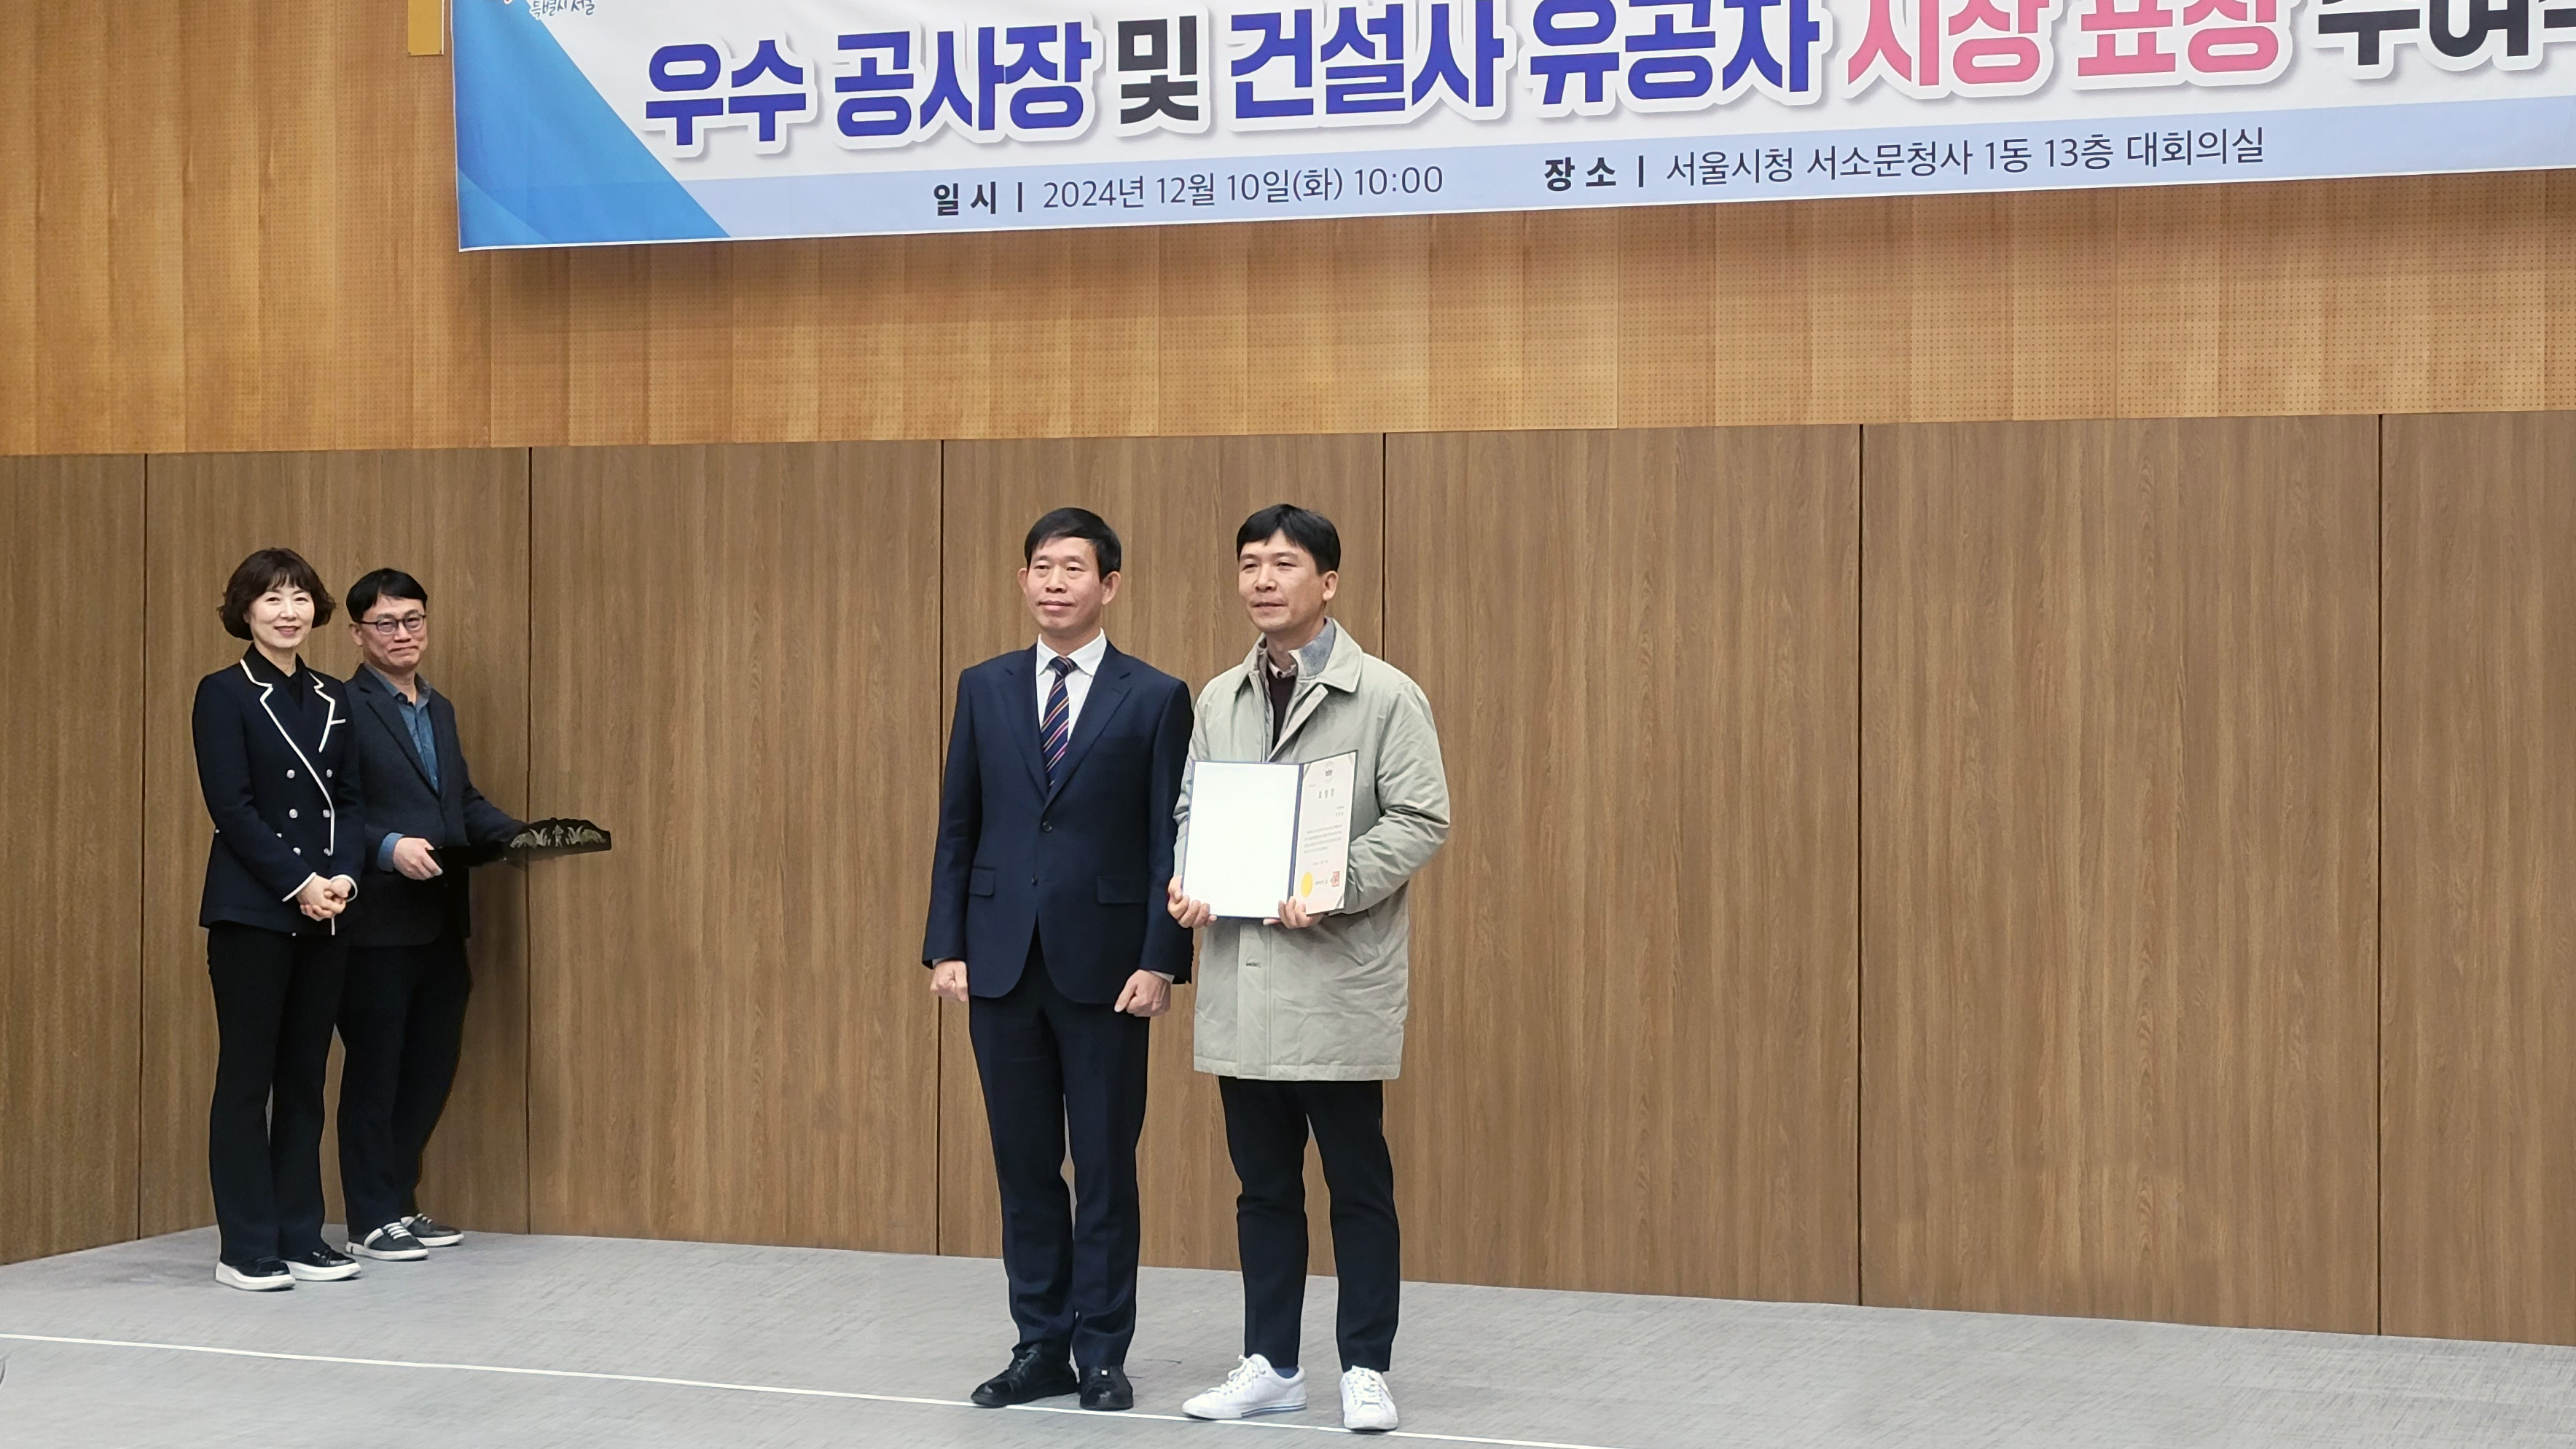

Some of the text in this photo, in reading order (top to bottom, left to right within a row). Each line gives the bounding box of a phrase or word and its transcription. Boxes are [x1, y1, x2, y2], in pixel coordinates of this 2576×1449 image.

[645, 39, 807, 146] 우수
[834, 21, 1092, 137] 공사장
[1117, 15, 1199, 125] 및
[1231, 0, 1505, 119] 건설사
[1530, 0, 1820, 105] 유공자
[1667, 147, 1793, 186] 서울시청
[1806, 139, 1973, 181] 서소문청사
[1985, 138, 2032, 173] 1동
[2045, 133, 2114, 170] 13층
[2127, 127, 2263, 168] 대회의실
[1044, 175, 1144, 208] 2024년
[1156, 173, 1215, 206] 12월
[1226, 168, 1343, 203] 10일(화)
[1354, 165, 1443, 196] 10:00
